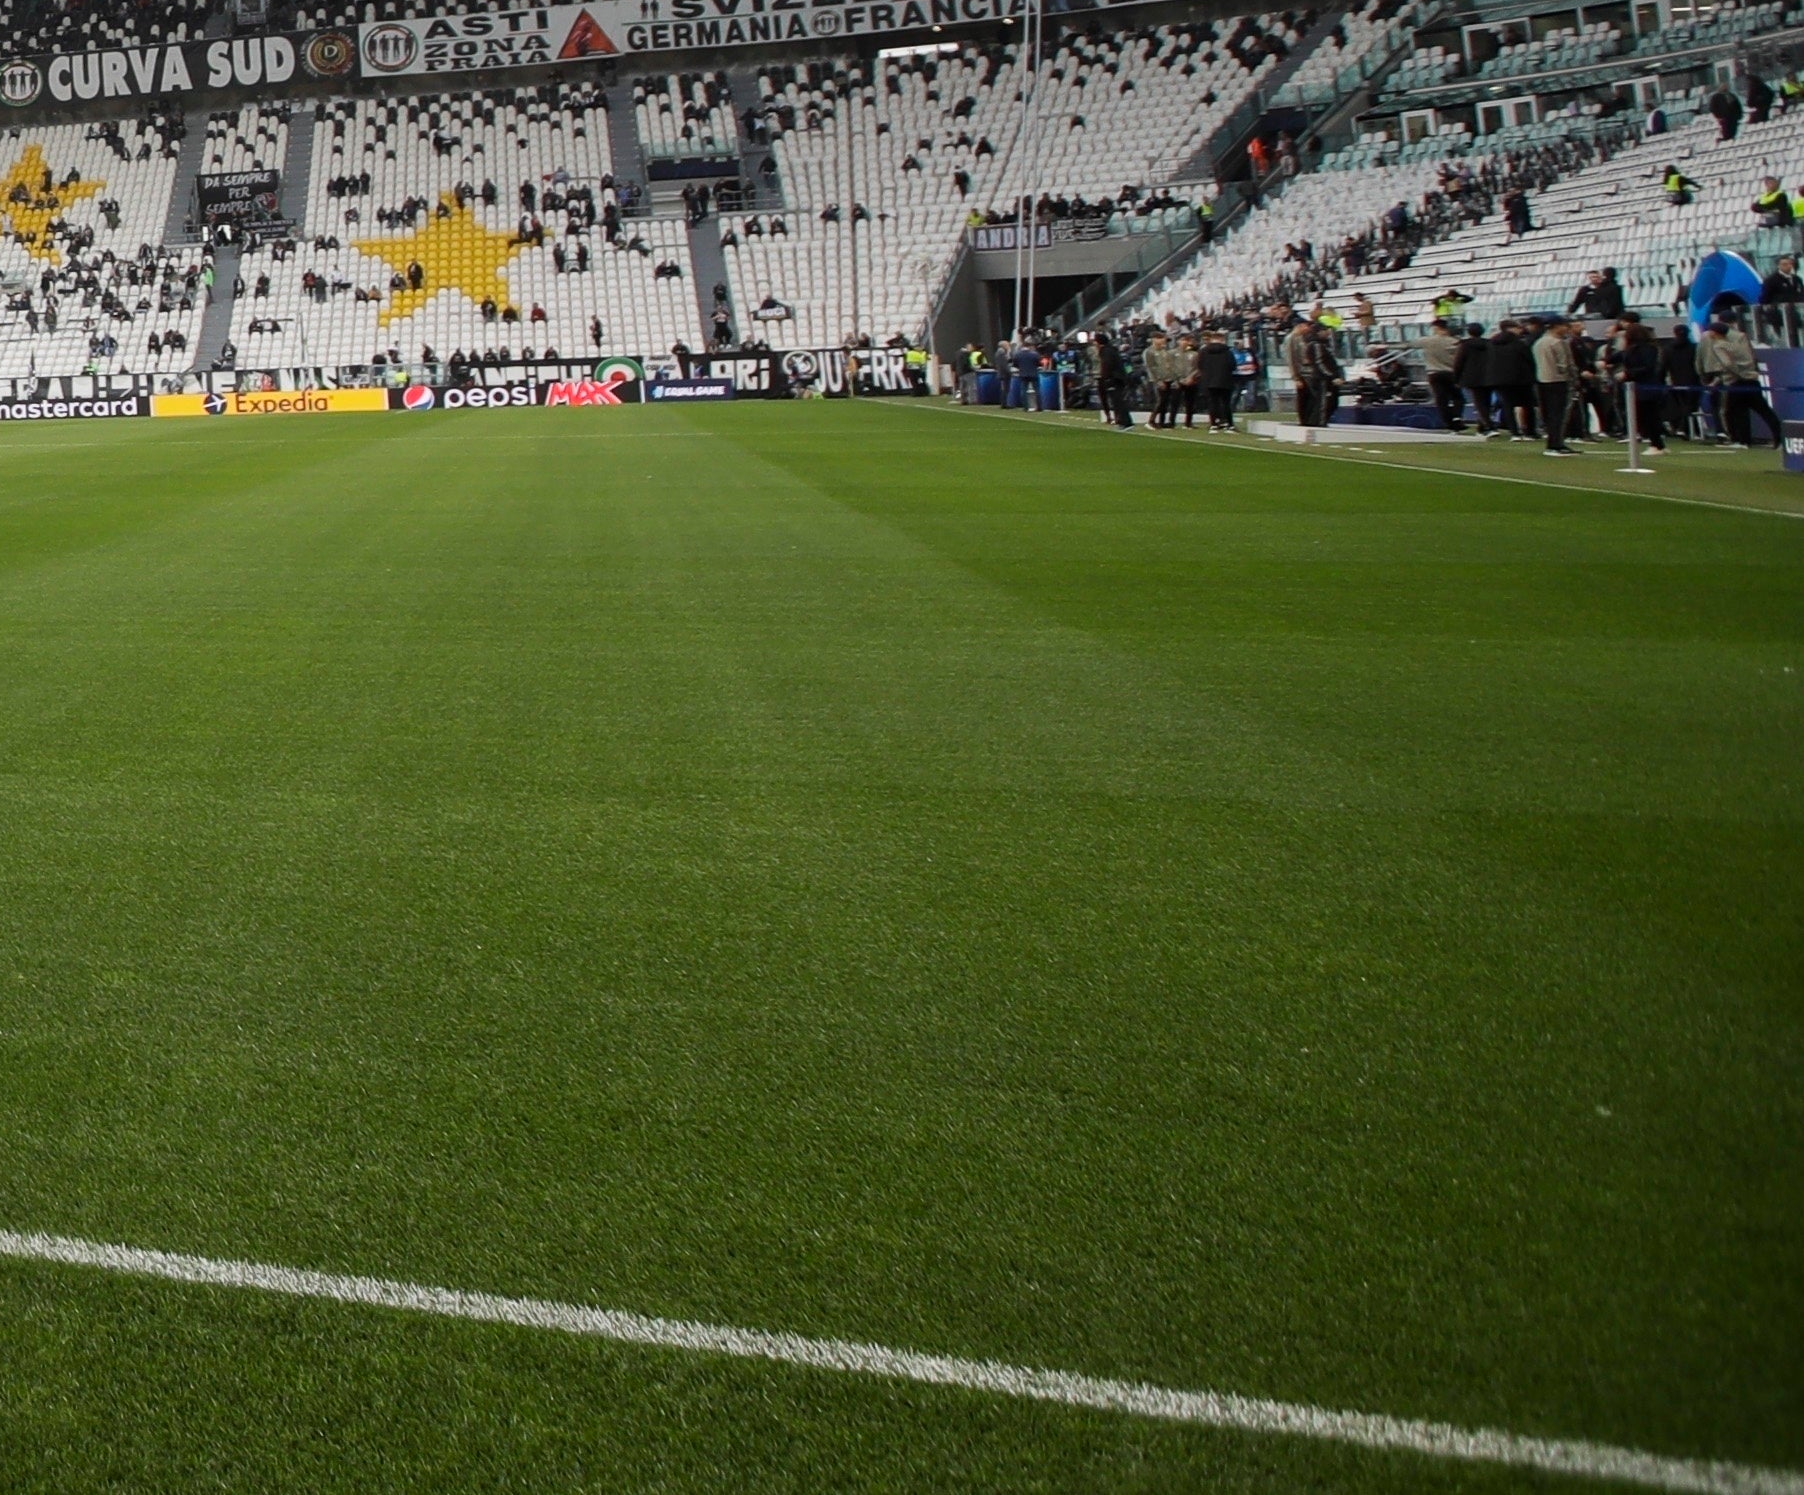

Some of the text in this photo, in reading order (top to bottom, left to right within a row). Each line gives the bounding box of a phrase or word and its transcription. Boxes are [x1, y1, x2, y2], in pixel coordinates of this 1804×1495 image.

[424, 10, 548, 39] ASTI
[627, 13, 808, 49] GERMANIA
[424, 35, 551, 58] ZONA
[425, 50, 551, 71] PRAIA
[48, 48, 192, 102] CURVA
[207, 37, 295, 88] SUD
[236, 393, 328, 413] Expedia
[445, 380, 623, 409] pepsi MAX
